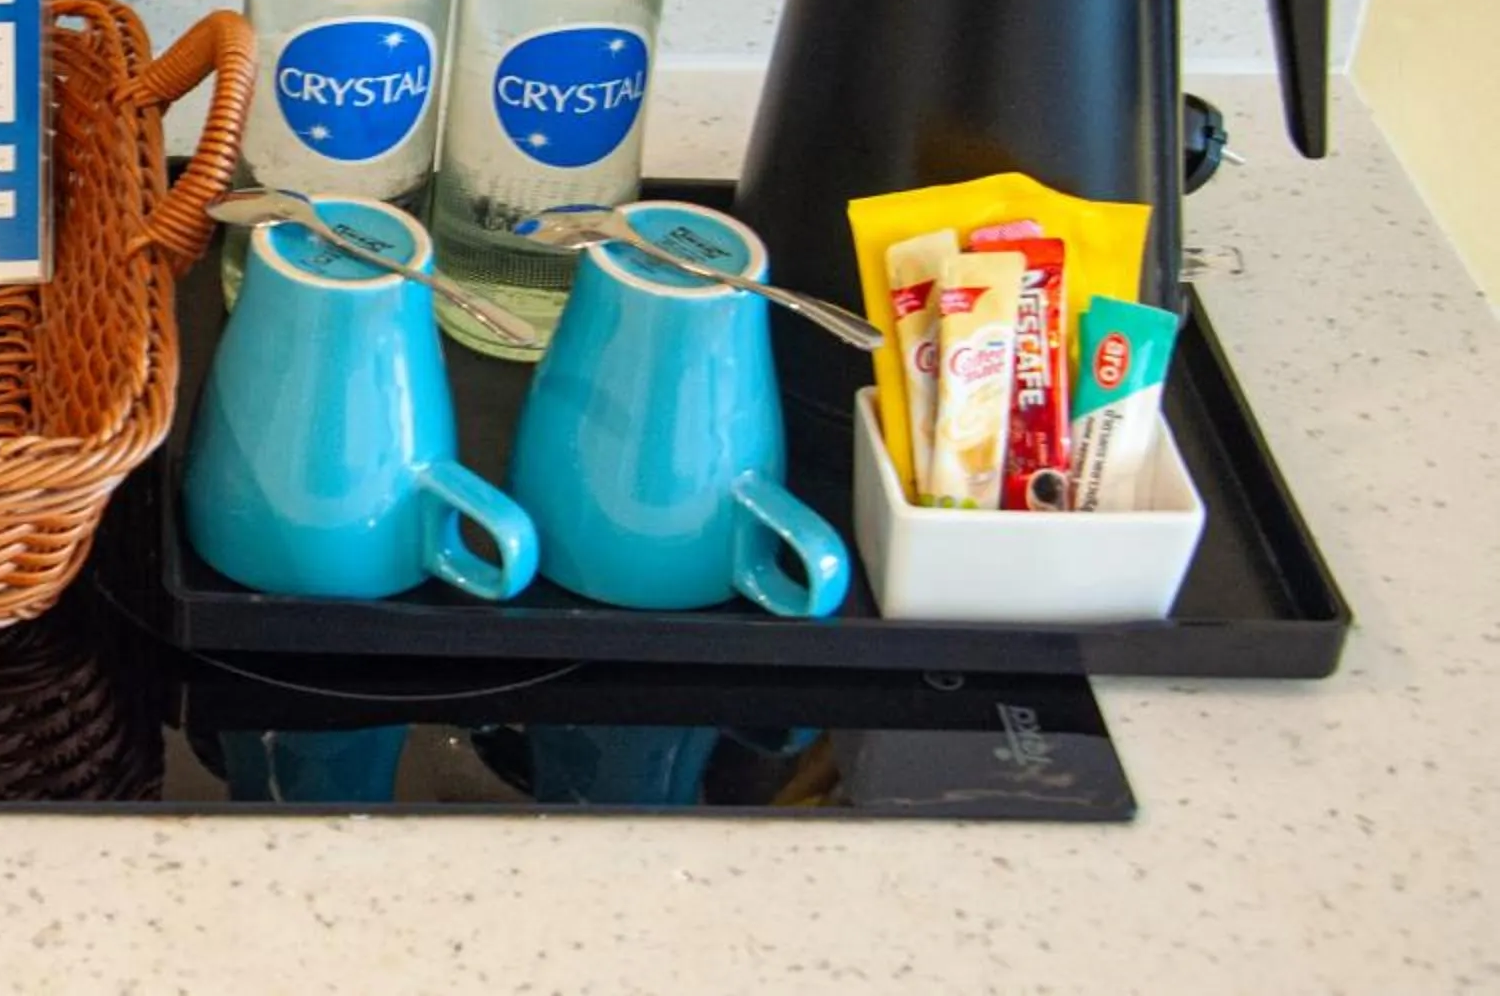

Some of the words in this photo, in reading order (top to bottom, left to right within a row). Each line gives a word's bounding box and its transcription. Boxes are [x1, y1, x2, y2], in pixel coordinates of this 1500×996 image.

[279, 65, 428, 107] CRYSTAL
[498, 71, 645, 114] CRYSTAL
[1100, 341, 1127, 383] aro
